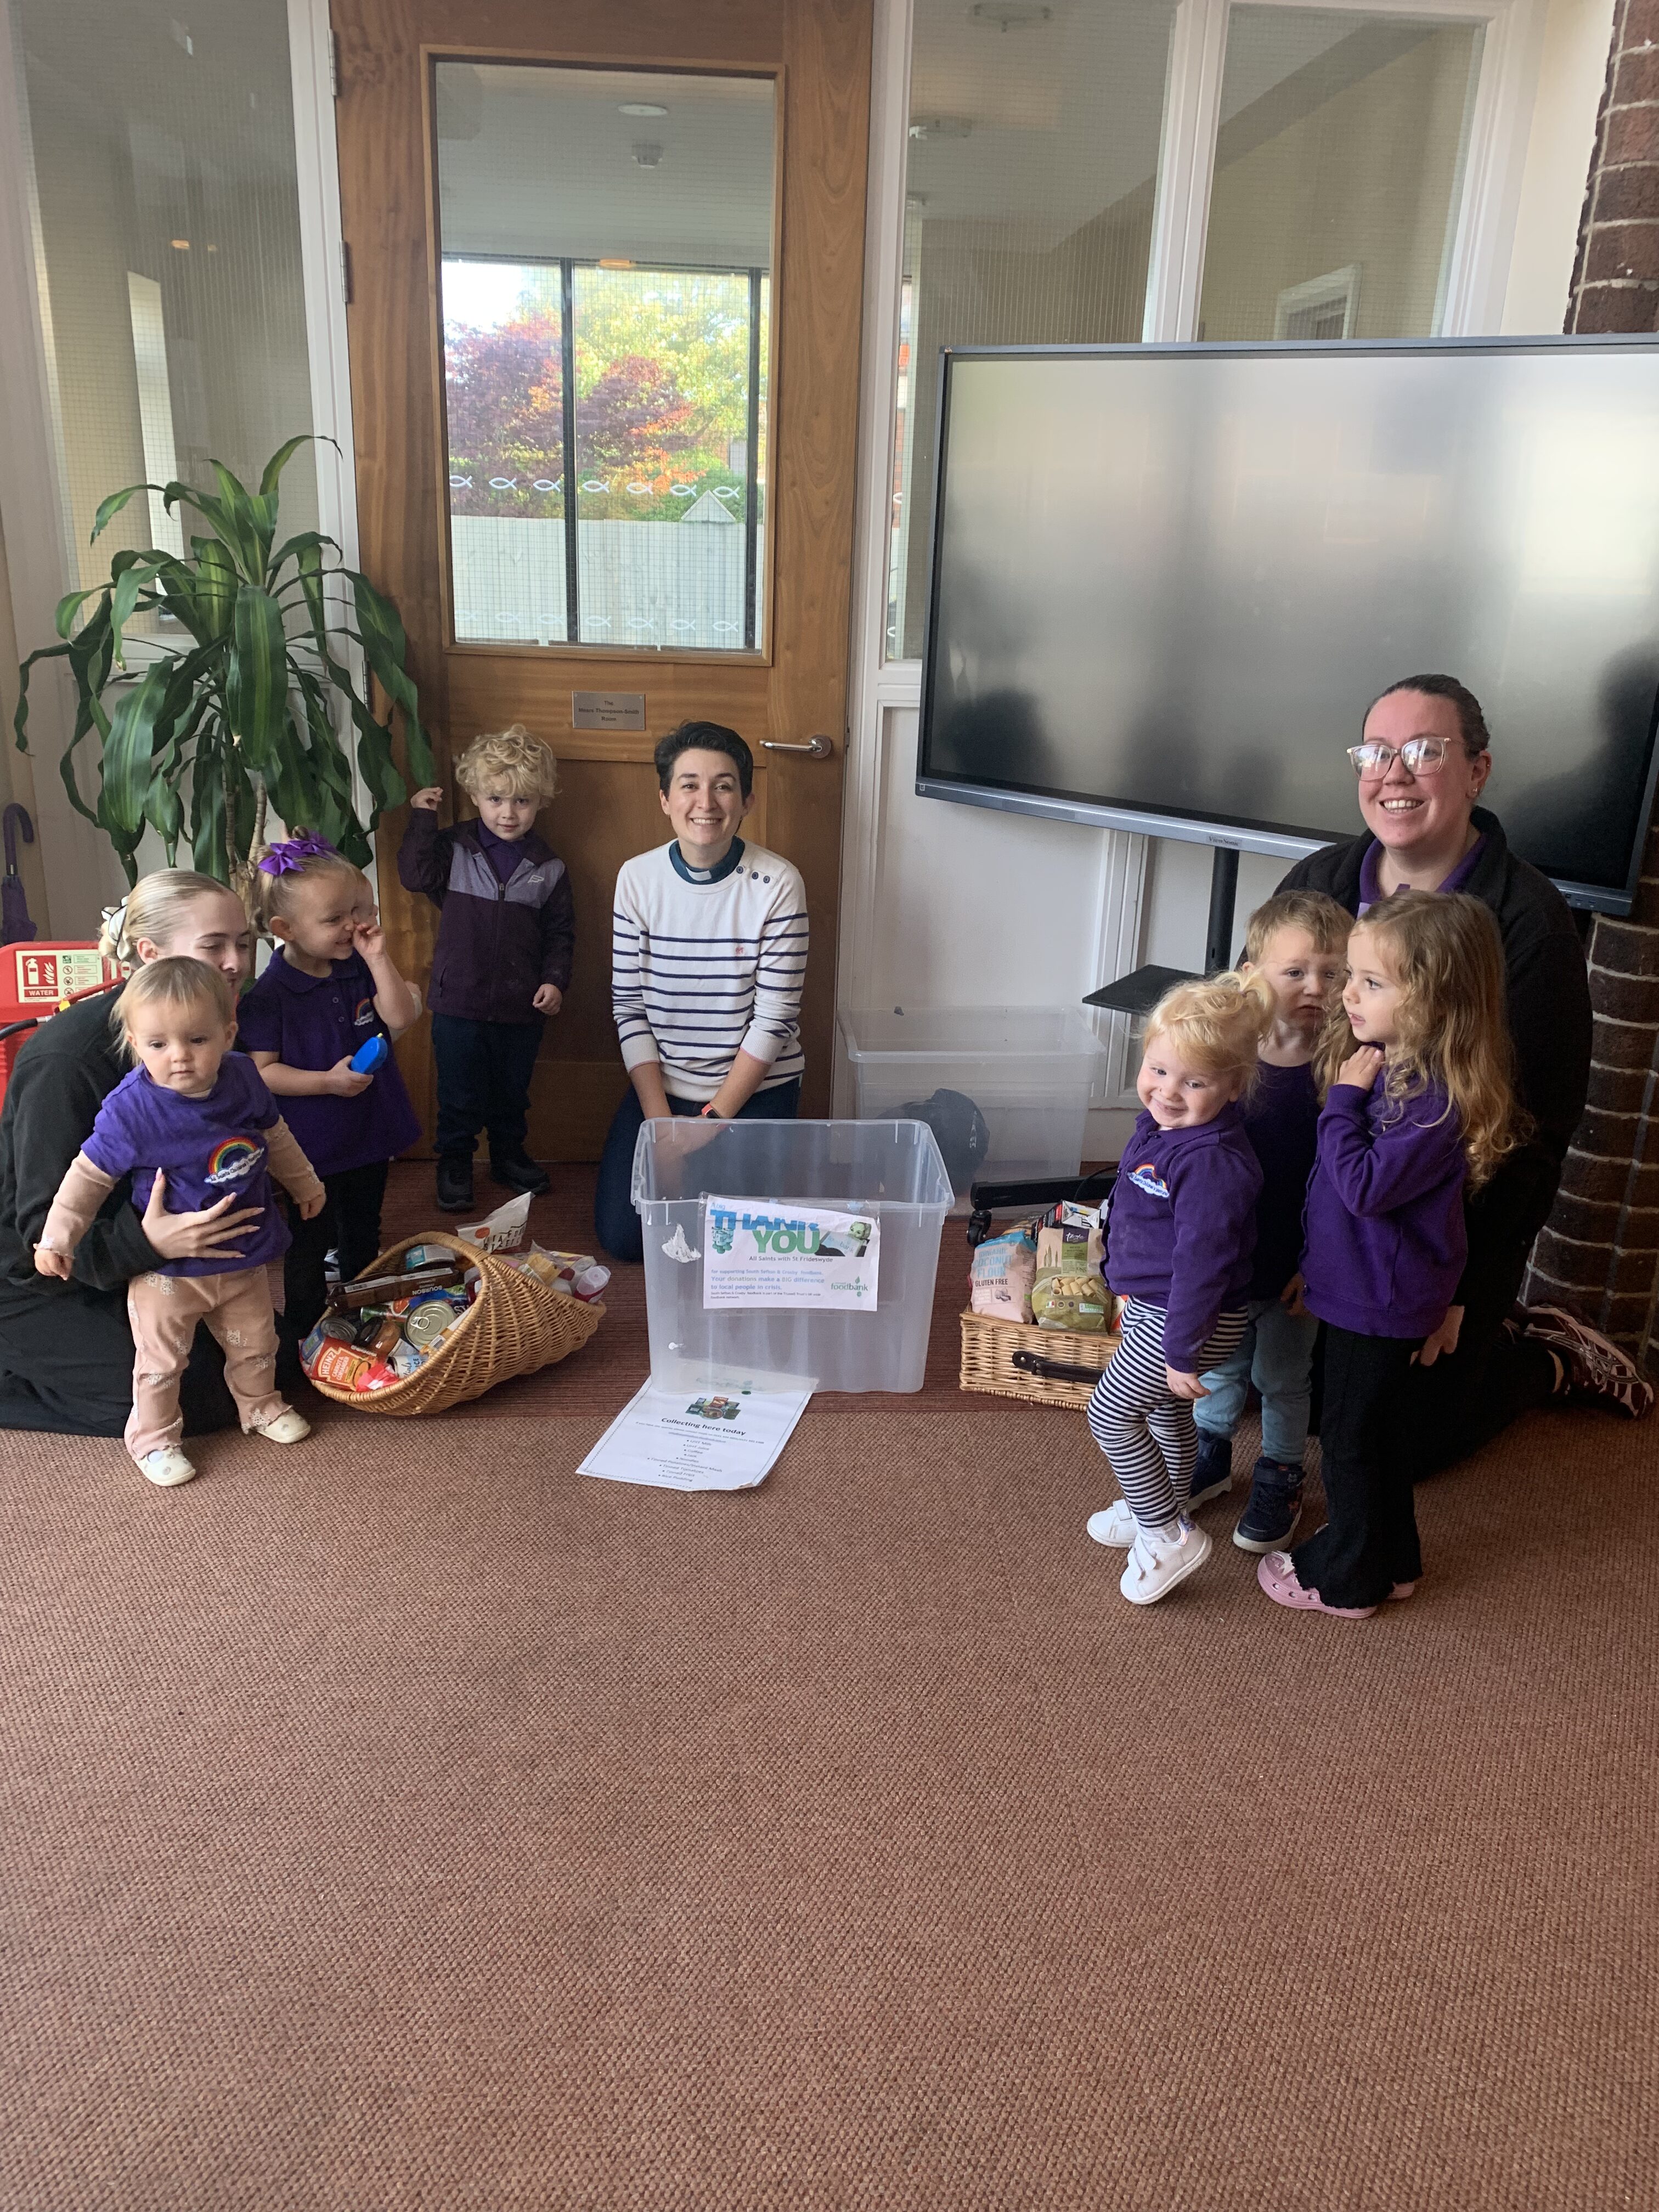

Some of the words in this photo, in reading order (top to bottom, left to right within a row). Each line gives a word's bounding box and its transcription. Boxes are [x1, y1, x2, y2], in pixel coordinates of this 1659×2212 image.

[752, 1229, 821, 1254] YOU
[831, 1283, 868, 1291] foodbank
[975, 1279, 994, 1288] GLUTEN
[412, 1285, 443, 1295] BOURBON
[321, 1351, 336, 1375] HEINZ
[336, 1356, 350, 1380] CORIANDER
[661, 1418, 701, 1429] Collecting
